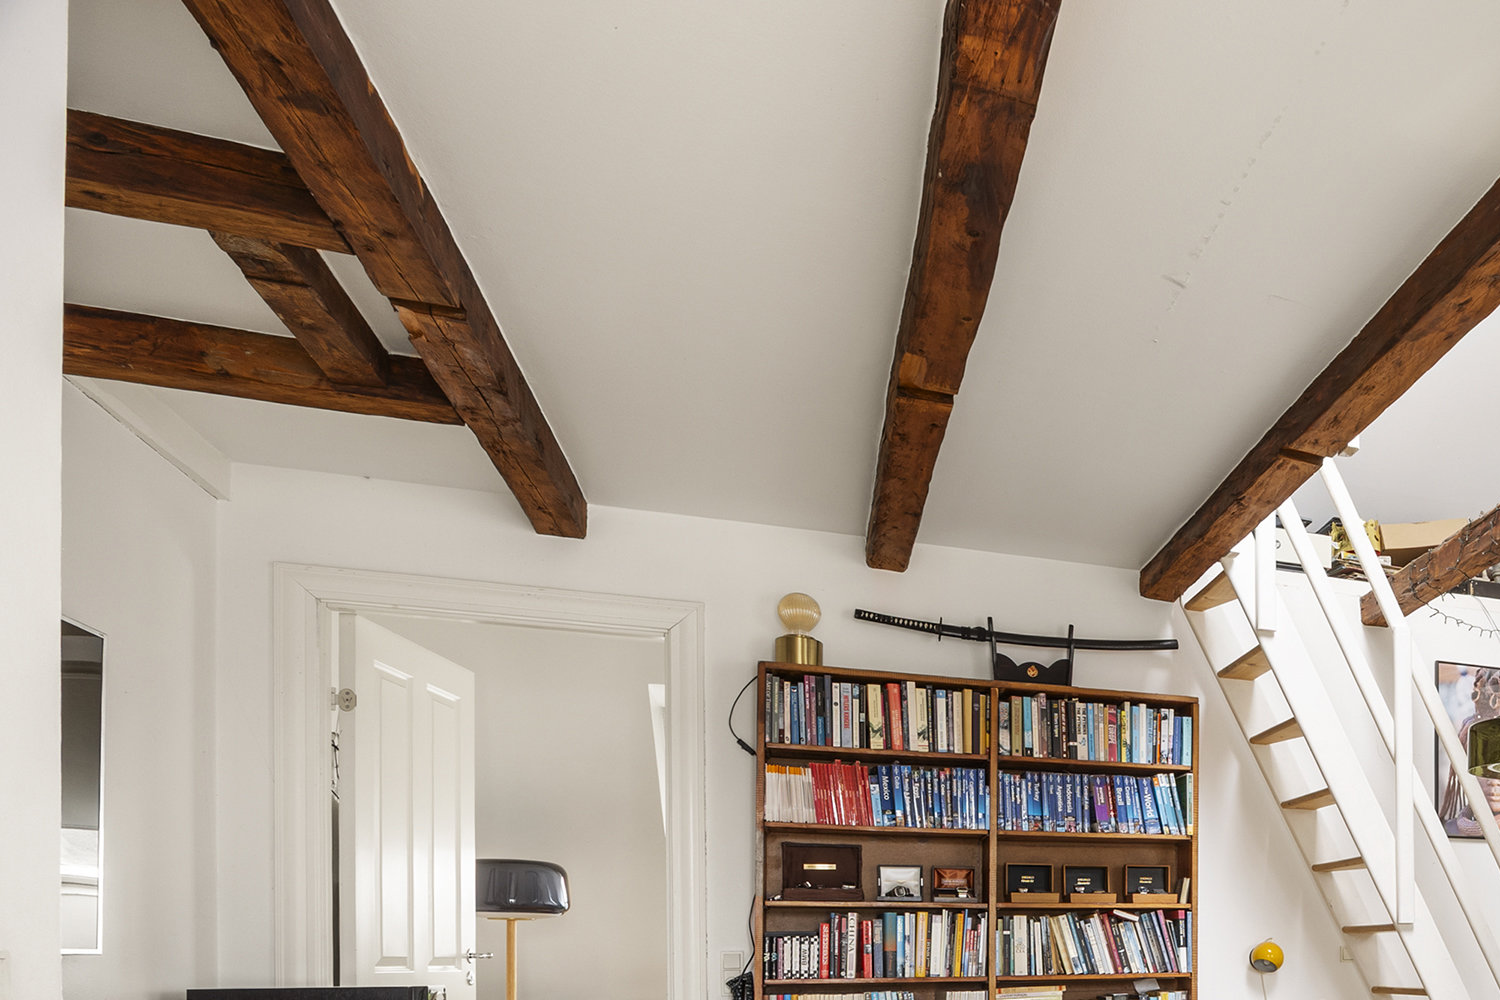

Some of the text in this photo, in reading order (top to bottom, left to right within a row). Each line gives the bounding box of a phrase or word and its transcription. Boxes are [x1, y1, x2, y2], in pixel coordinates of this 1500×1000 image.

[882, 776, 891, 800] Mexico
[1116, 787, 1124, 805] Brazil
[1144, 794, 1154, 818] World
